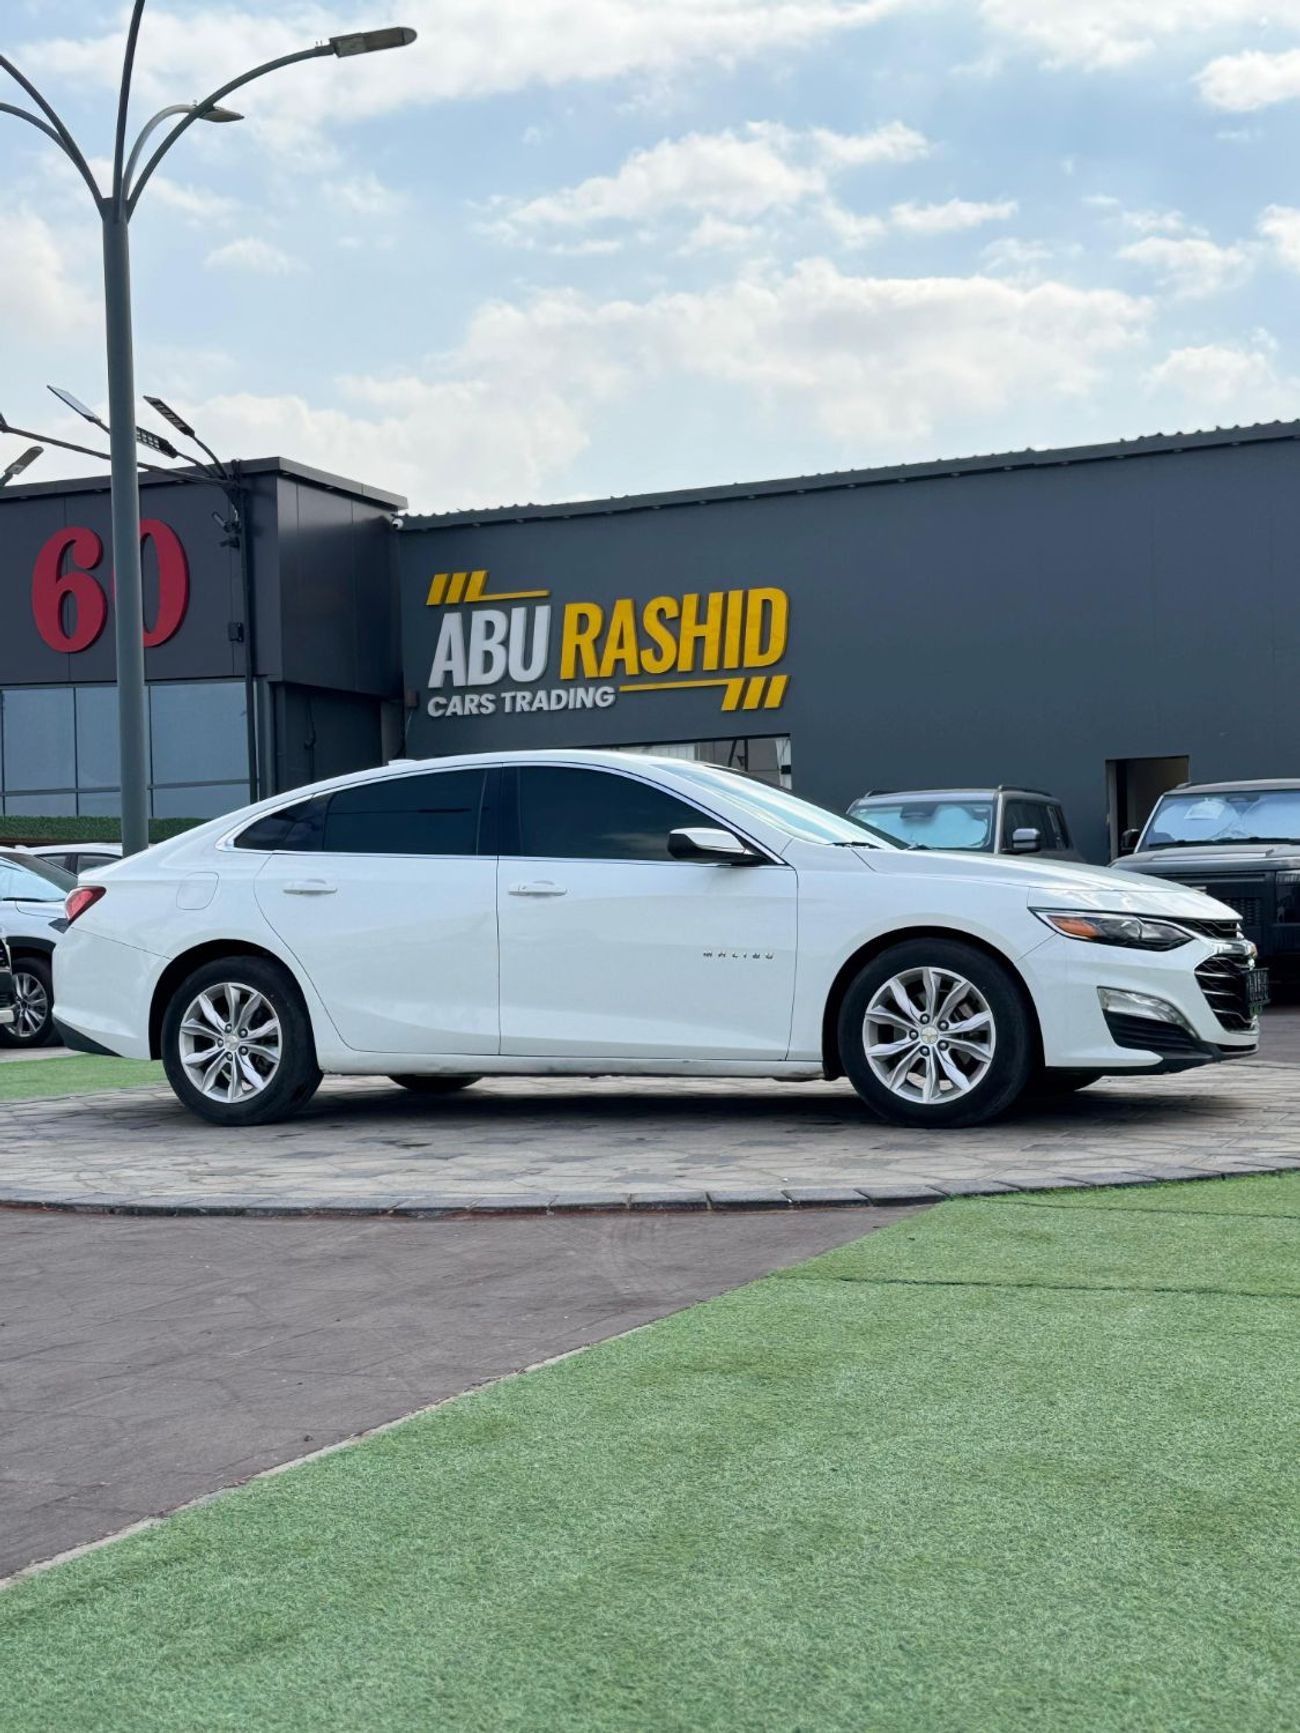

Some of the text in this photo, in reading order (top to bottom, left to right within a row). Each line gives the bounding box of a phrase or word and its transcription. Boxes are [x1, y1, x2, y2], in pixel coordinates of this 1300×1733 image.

[32, 519, 190, 653] 60
[428, 587, 789, 688] ABU RASHID
[427, 686, 616, 718] CARS TRADING
